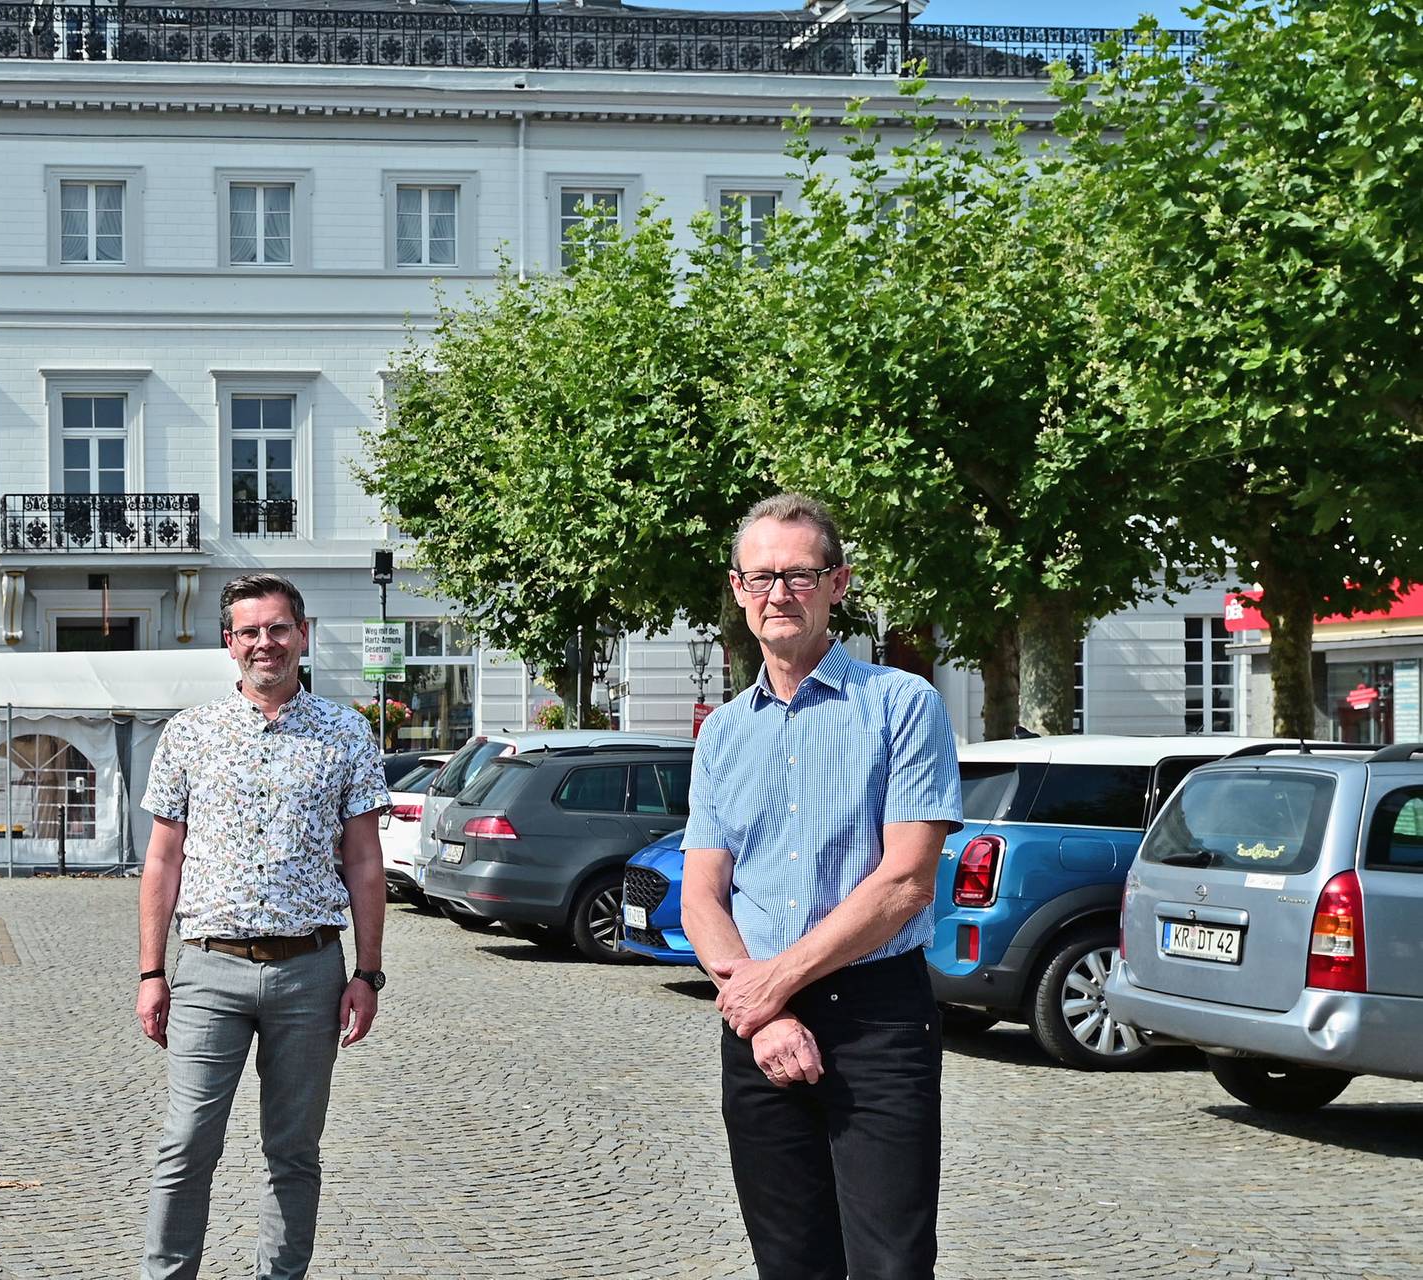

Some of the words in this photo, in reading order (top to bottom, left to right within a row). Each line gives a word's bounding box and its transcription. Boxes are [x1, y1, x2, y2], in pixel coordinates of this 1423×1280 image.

[364, 627, 378, 635] Weg
[379, 627, 388, 635] mit
[388, 627, 399, 635] den
[364, 645, 391, 653] Gesetzen
[1173, 926, 1190, 949] KR
[1197, 929, 1215, 951] DT
[1217, 932, 1234, 954] 42
